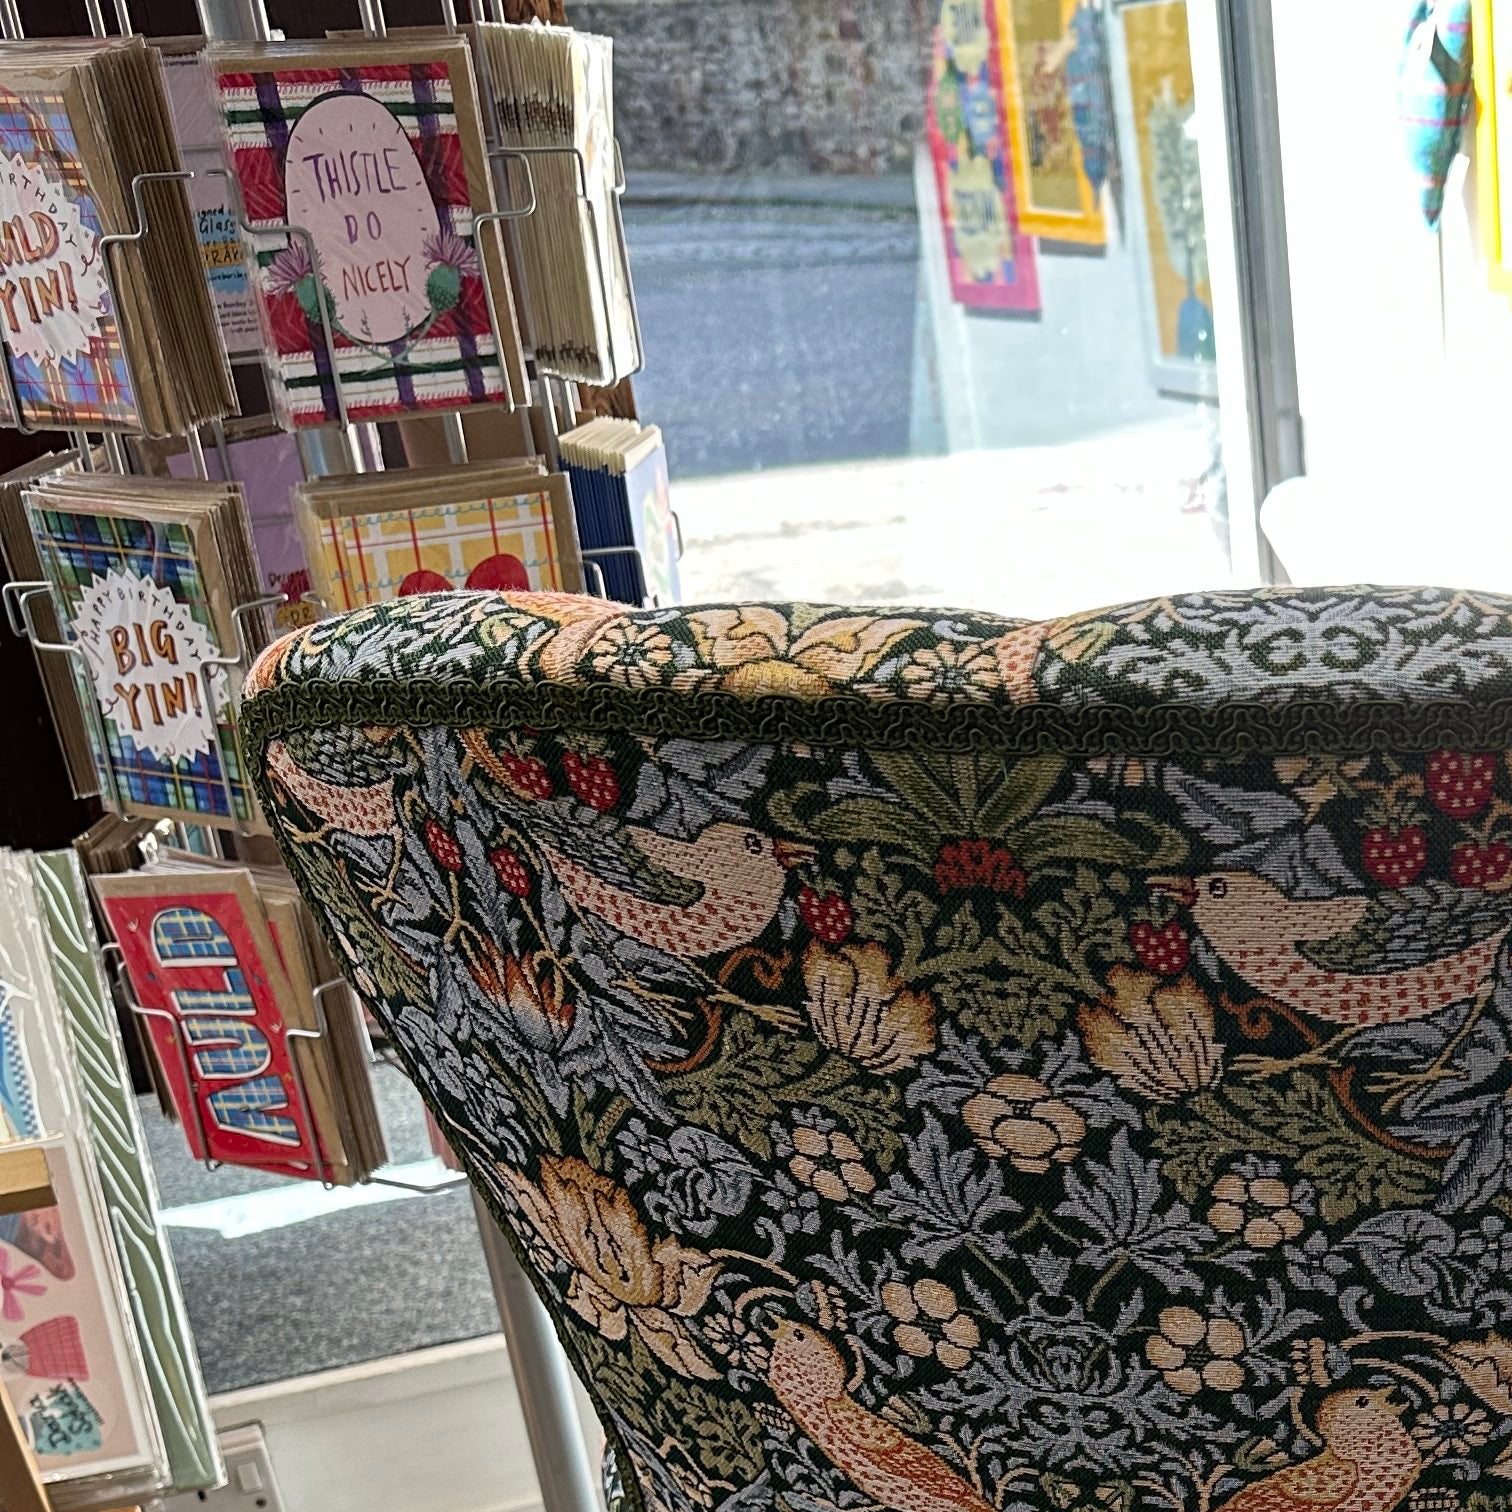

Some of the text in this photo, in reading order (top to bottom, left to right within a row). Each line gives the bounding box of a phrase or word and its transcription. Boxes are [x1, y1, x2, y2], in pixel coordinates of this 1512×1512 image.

[302, 148, 407, 203] THISTLE
[344, 211, 382, 244] DO
[342, 255, 411, 301] NICELY
[90, 588, 201, 660] HAPPY BIRTHDAY
[106, 619, 178, 676] BIG
[113, 672, 203, 731] YIN!
[152, 907, 301, 1147] AULD
